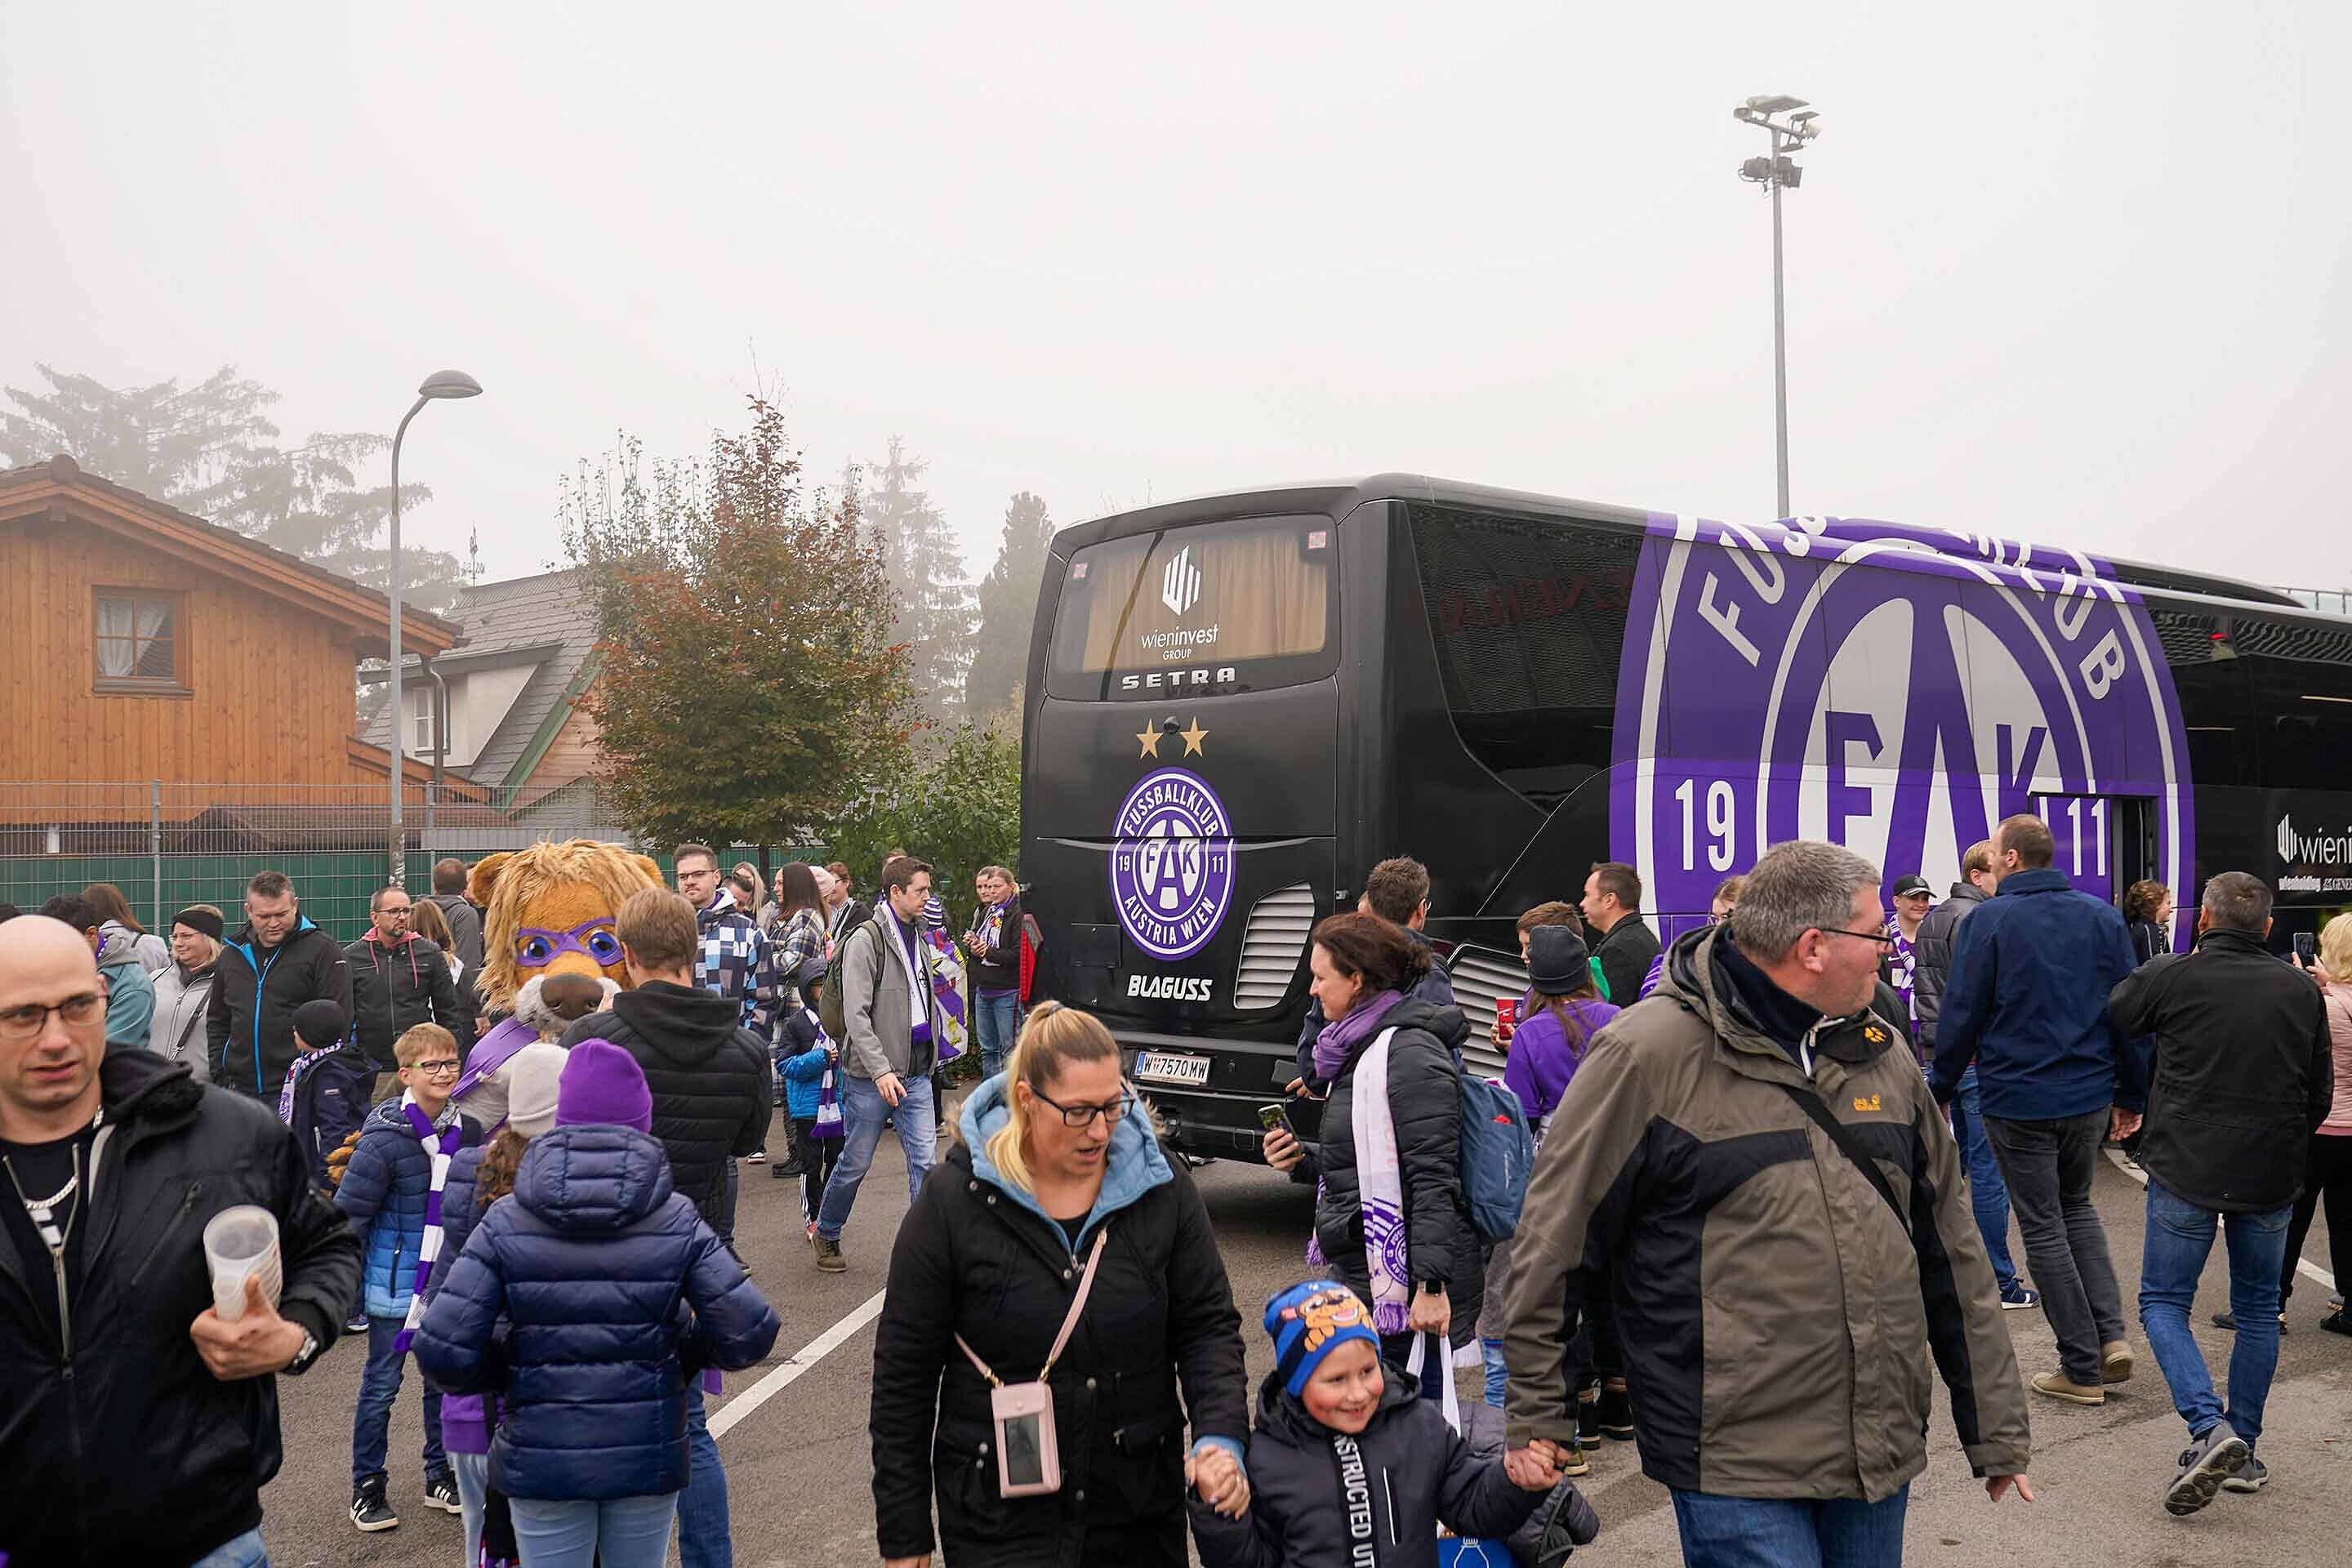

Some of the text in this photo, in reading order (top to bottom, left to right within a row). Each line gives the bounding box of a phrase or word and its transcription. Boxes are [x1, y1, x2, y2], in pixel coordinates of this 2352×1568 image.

[1141, 623, 1218, 648] wieninvest
[1163, 648, 1192, 661] GROUP
[1122, 667, 1236, 690] SETRA
[1124, 783, 1218, 836] FUSSBALLKLUB
[1675, 778, 1735, 871] 19
[2067, 797, 2105, 875] 11
[1119, 855, 1130, 872] 19
[1212, 855, 1223, 873] 11
[1125, 895, 1215, 945] AUSTRIA WIEN
[1127, 975, 1213, 1001] BLAGUSS
